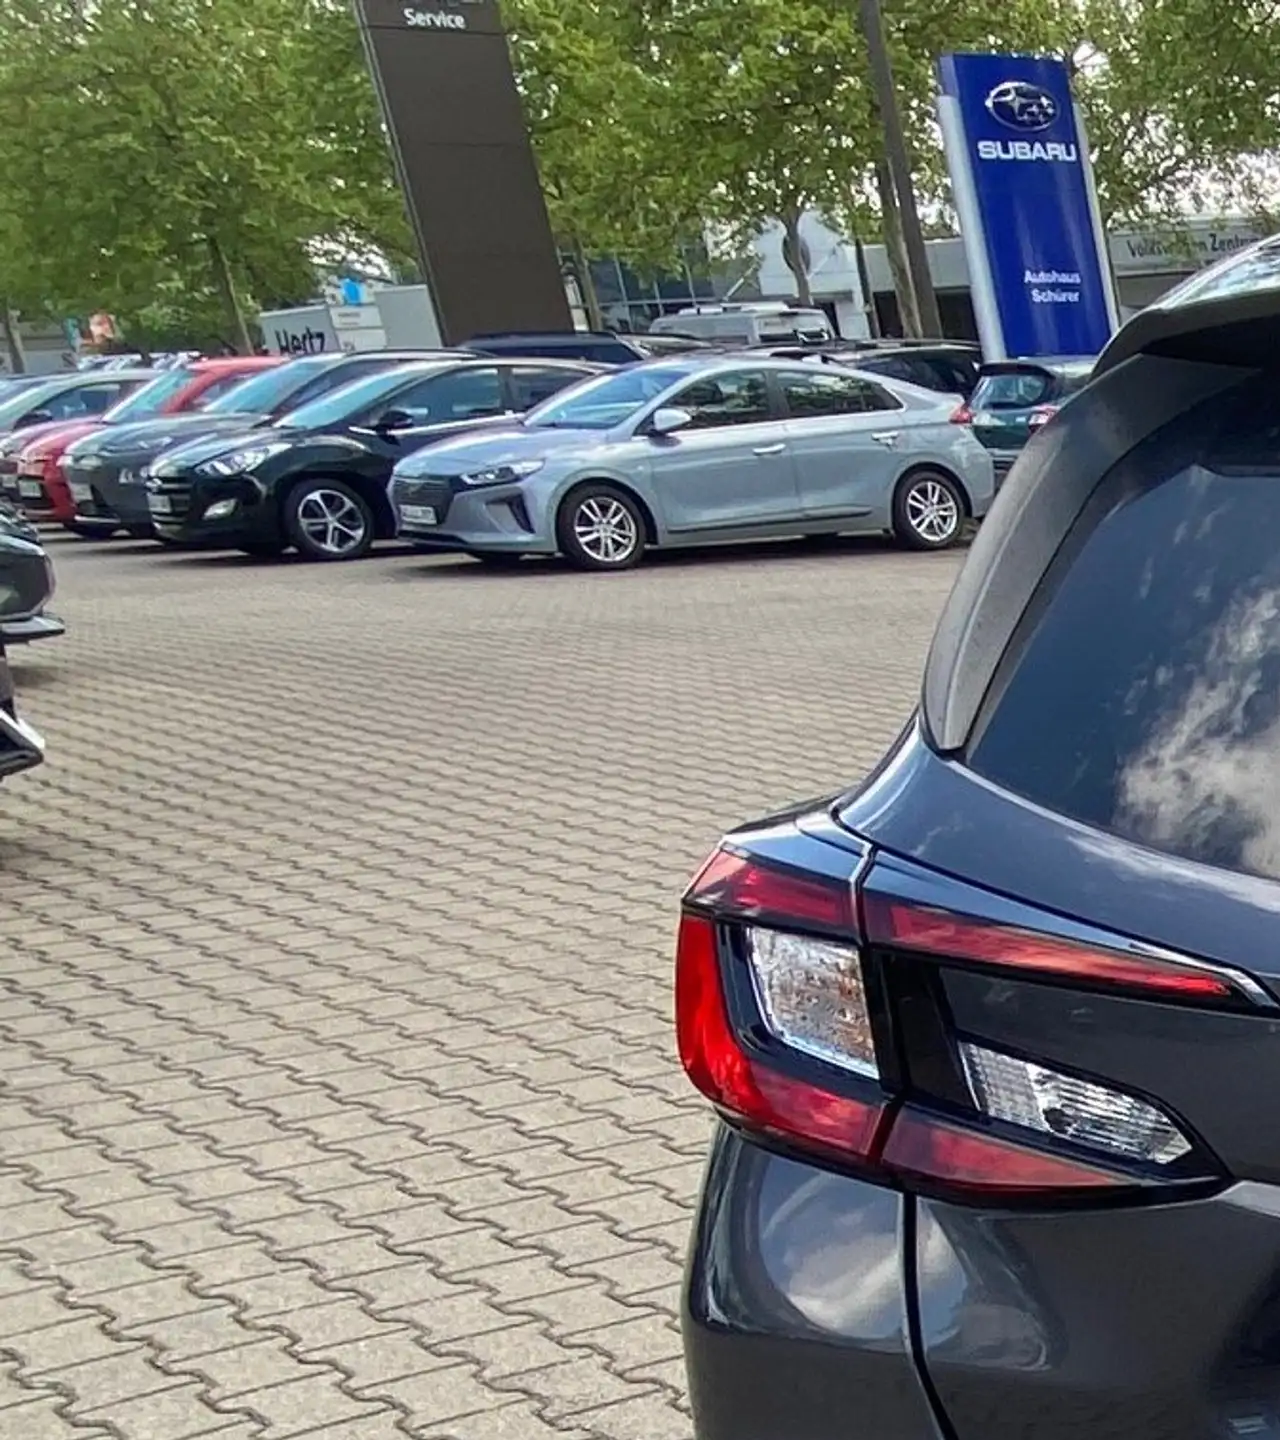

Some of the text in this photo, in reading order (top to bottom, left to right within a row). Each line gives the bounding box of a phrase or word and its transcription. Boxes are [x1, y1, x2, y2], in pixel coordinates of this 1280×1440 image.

[403, 8, 466, 29] Service
[977, 140, 1077, 162] SUBARU
[1024, 270, 1081, 284] Autohaus
[1031, 288, 1080, 303] Schürer
[275, 326, 325, 354] Hertz
